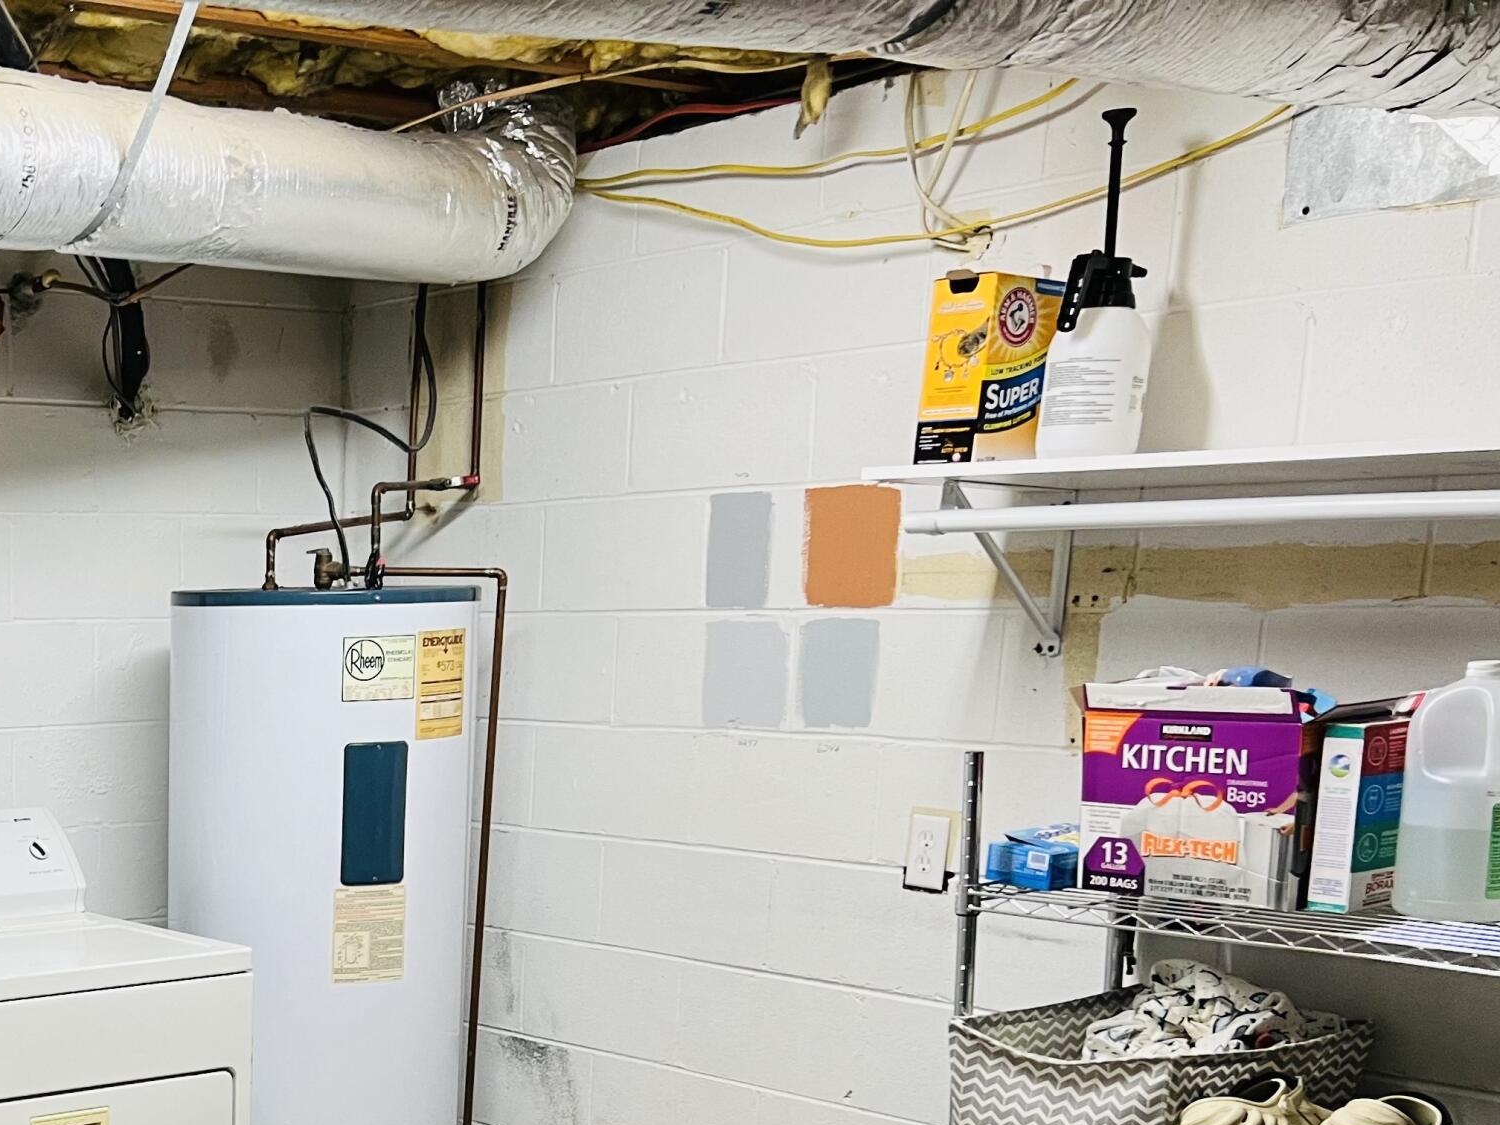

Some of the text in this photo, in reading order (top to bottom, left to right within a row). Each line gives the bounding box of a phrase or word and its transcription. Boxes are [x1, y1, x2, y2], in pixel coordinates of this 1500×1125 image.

[984, 377, 1040, 410] SUPER
[350, 640, 383, 674] Rheem
[1121, 743, 1248, 776] KITCHEN
[1227, 786, 1266, 808] Bags
[1101, 841, 1128, 865] 13
[1089, 874, 1108, 886] 200
[1109, 876, 1138, 890] BAGS
